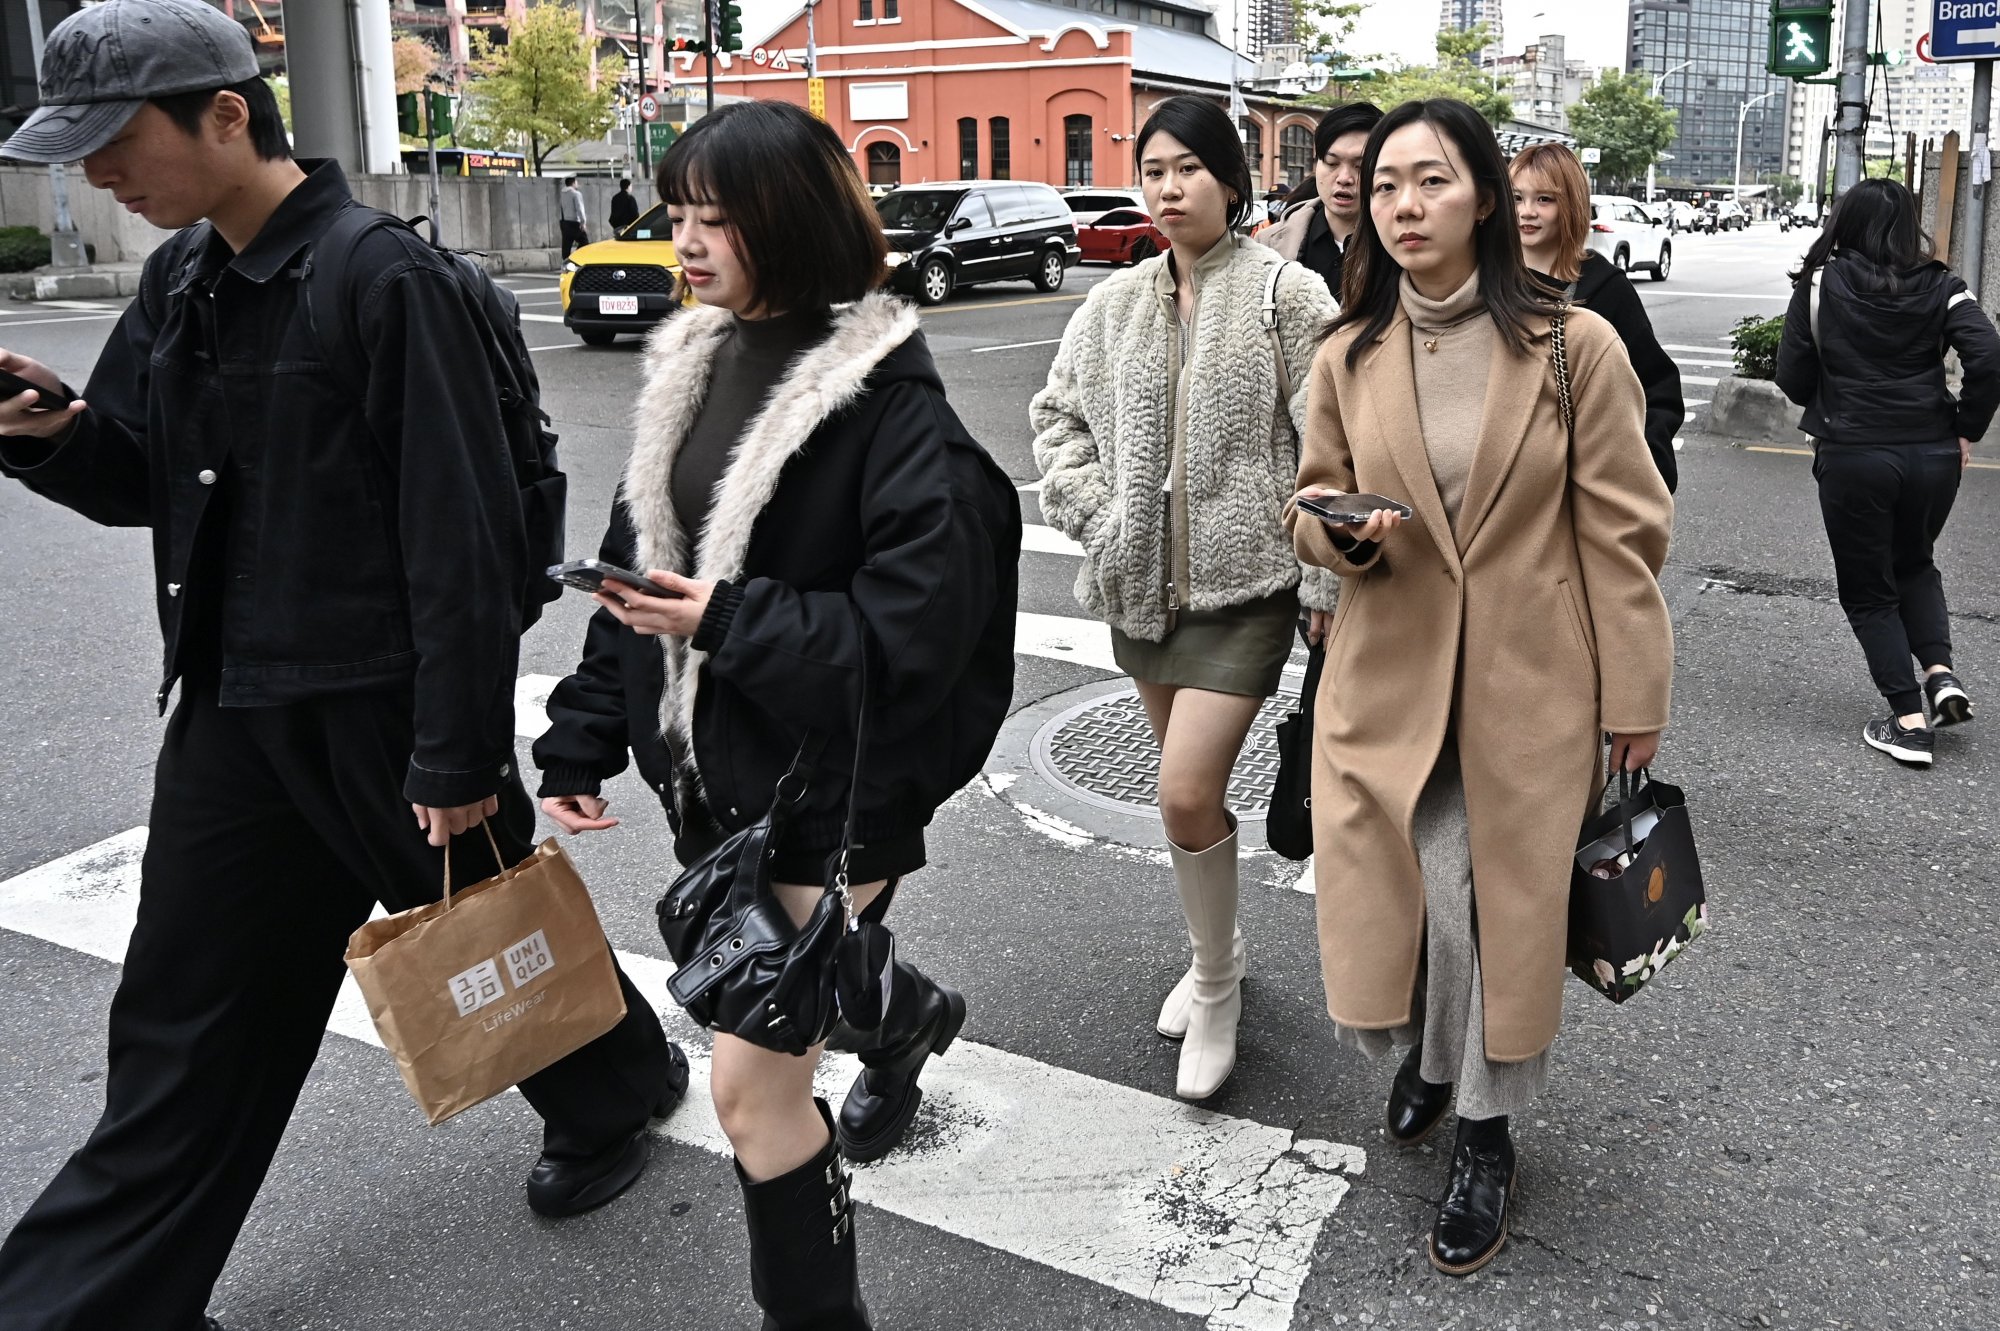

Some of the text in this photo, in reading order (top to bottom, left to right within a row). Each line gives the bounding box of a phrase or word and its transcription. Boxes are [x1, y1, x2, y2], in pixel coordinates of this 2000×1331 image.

[754, 52, 766, 61] 40
[643, 103, 654, 112] 40
[1881, 724, 1891, 740] N
[511, 938, 540, 965] UNI
[457, 966, 492, 993] ユニ
[516, 952, 547, 980] QLO
[463, 981, 497, 1010] クロ
[481, 990, 546, 1033] LifeWear
